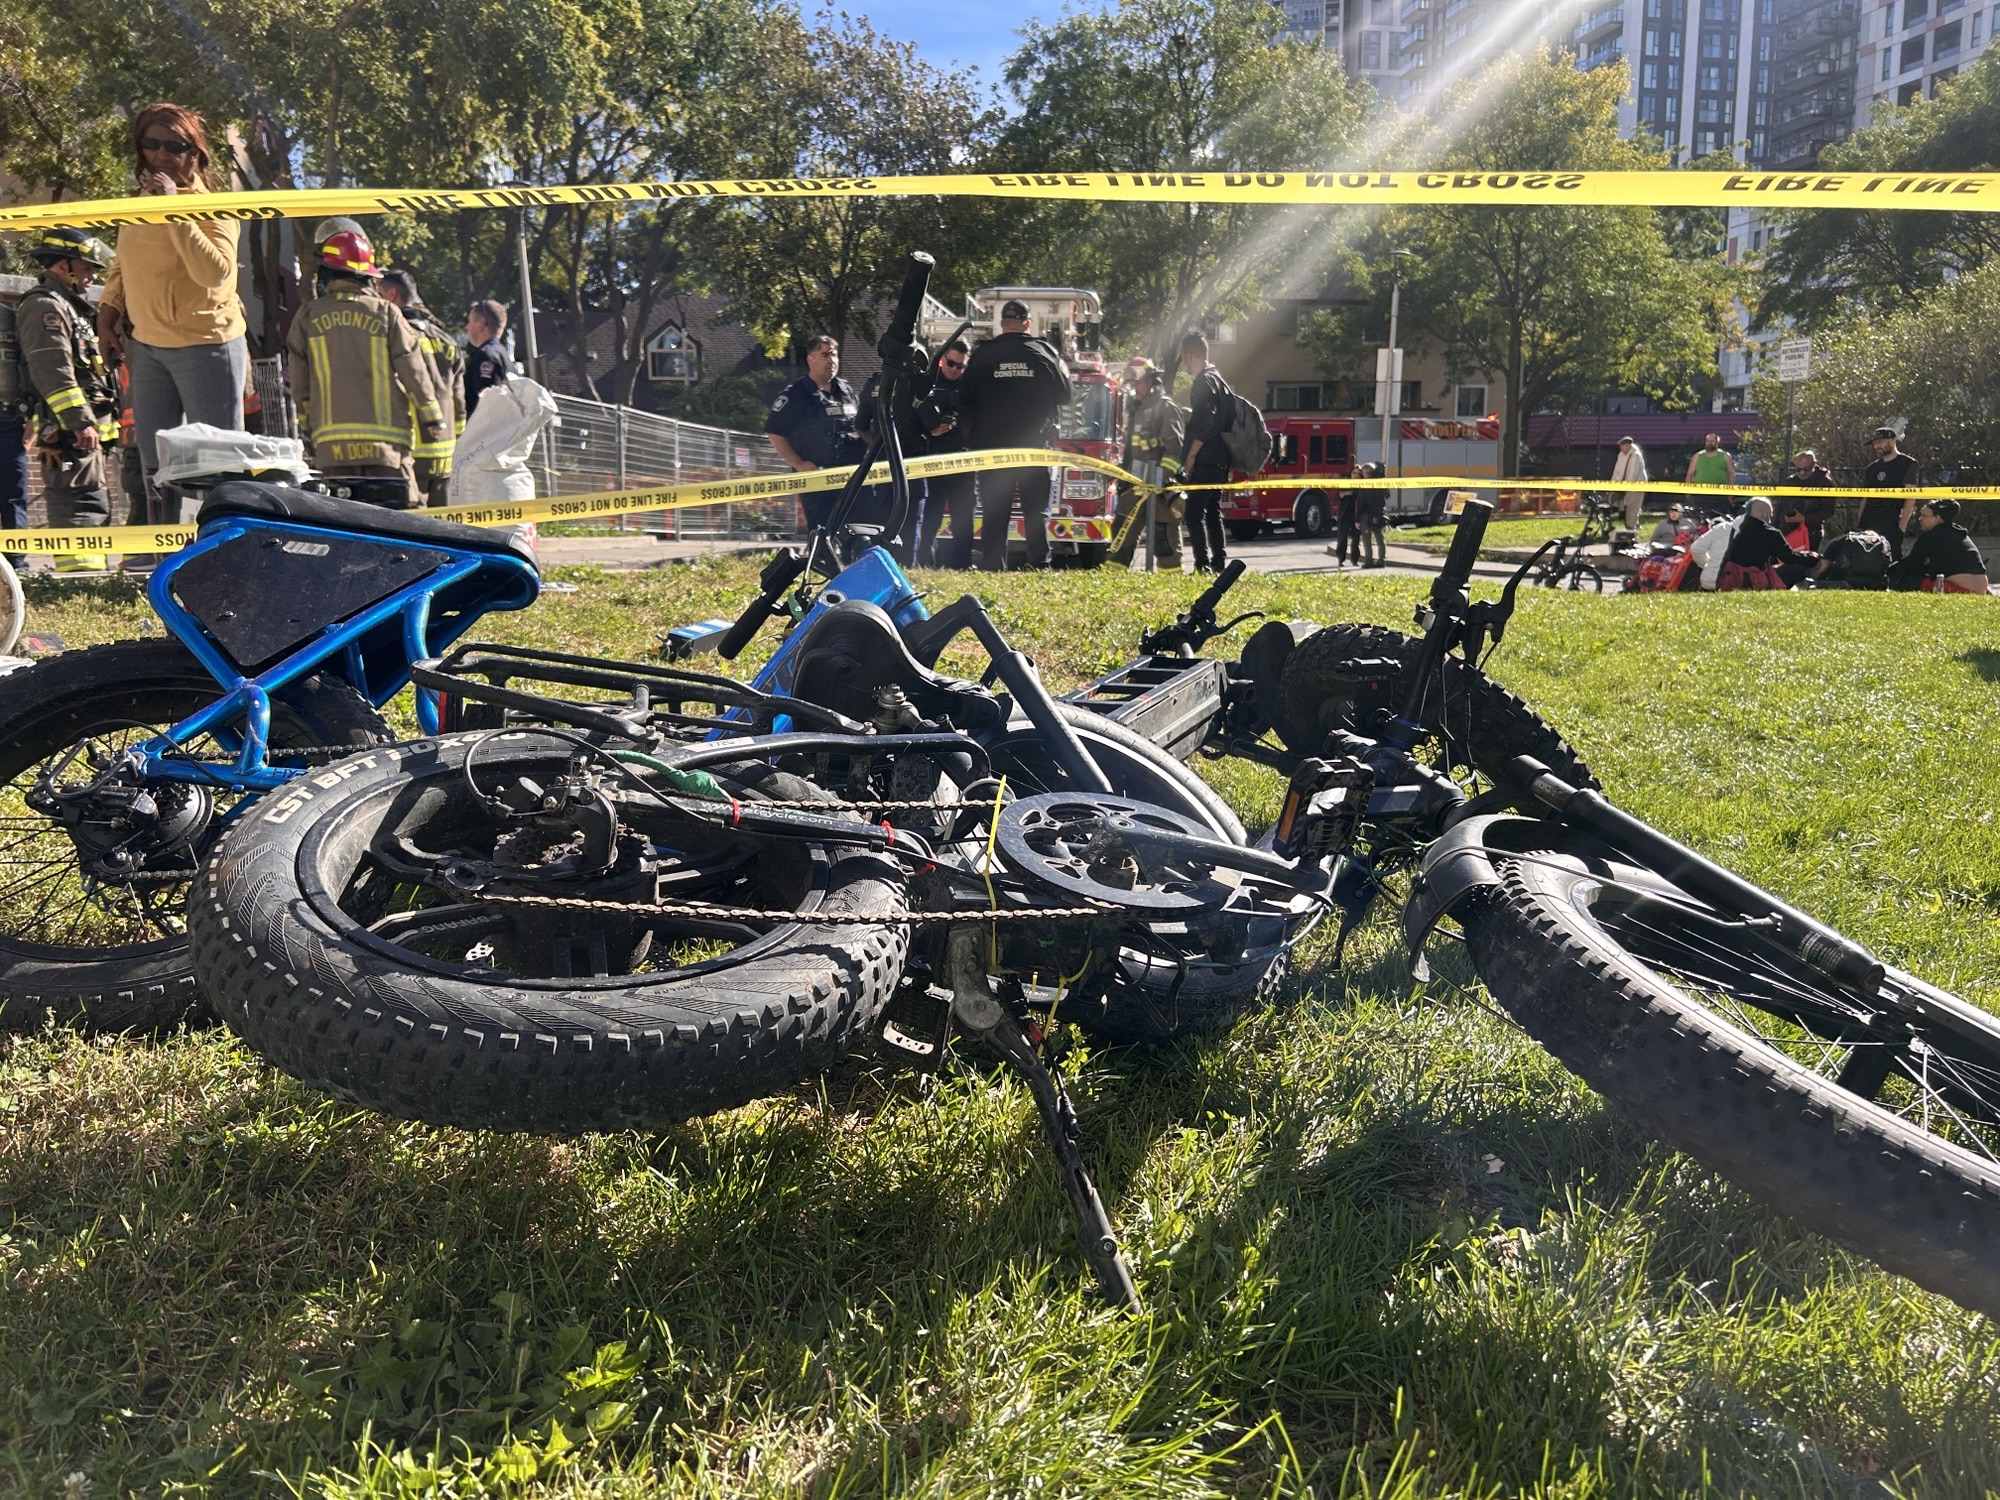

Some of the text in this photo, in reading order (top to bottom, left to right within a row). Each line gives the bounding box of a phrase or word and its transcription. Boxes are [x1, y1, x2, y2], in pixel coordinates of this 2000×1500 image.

[311, 310, 382, 335] TORONTO
[999, 362, 1028, 370] SPECIAL
[993, 370, 1034, 378] CONSTABLE
[825, 472, 850, 485] CROSS
[701, 478, 806, 499] FIRE LINE DO NOT CROSS
[551, 491, 677, 515] FIRE LINE DO NOT CROSS
[467, 510, 493, 523] LINE
[497, 508, 522, 521] FIRE
[5, 536, 113, 550] FIRE LINE DO
[155, 532, 195, 547] ROSS
[264, 786, 315, 824] CST
[312, 755, 377, 789] BFT
[420, 915, 491, 933] BAFANG
